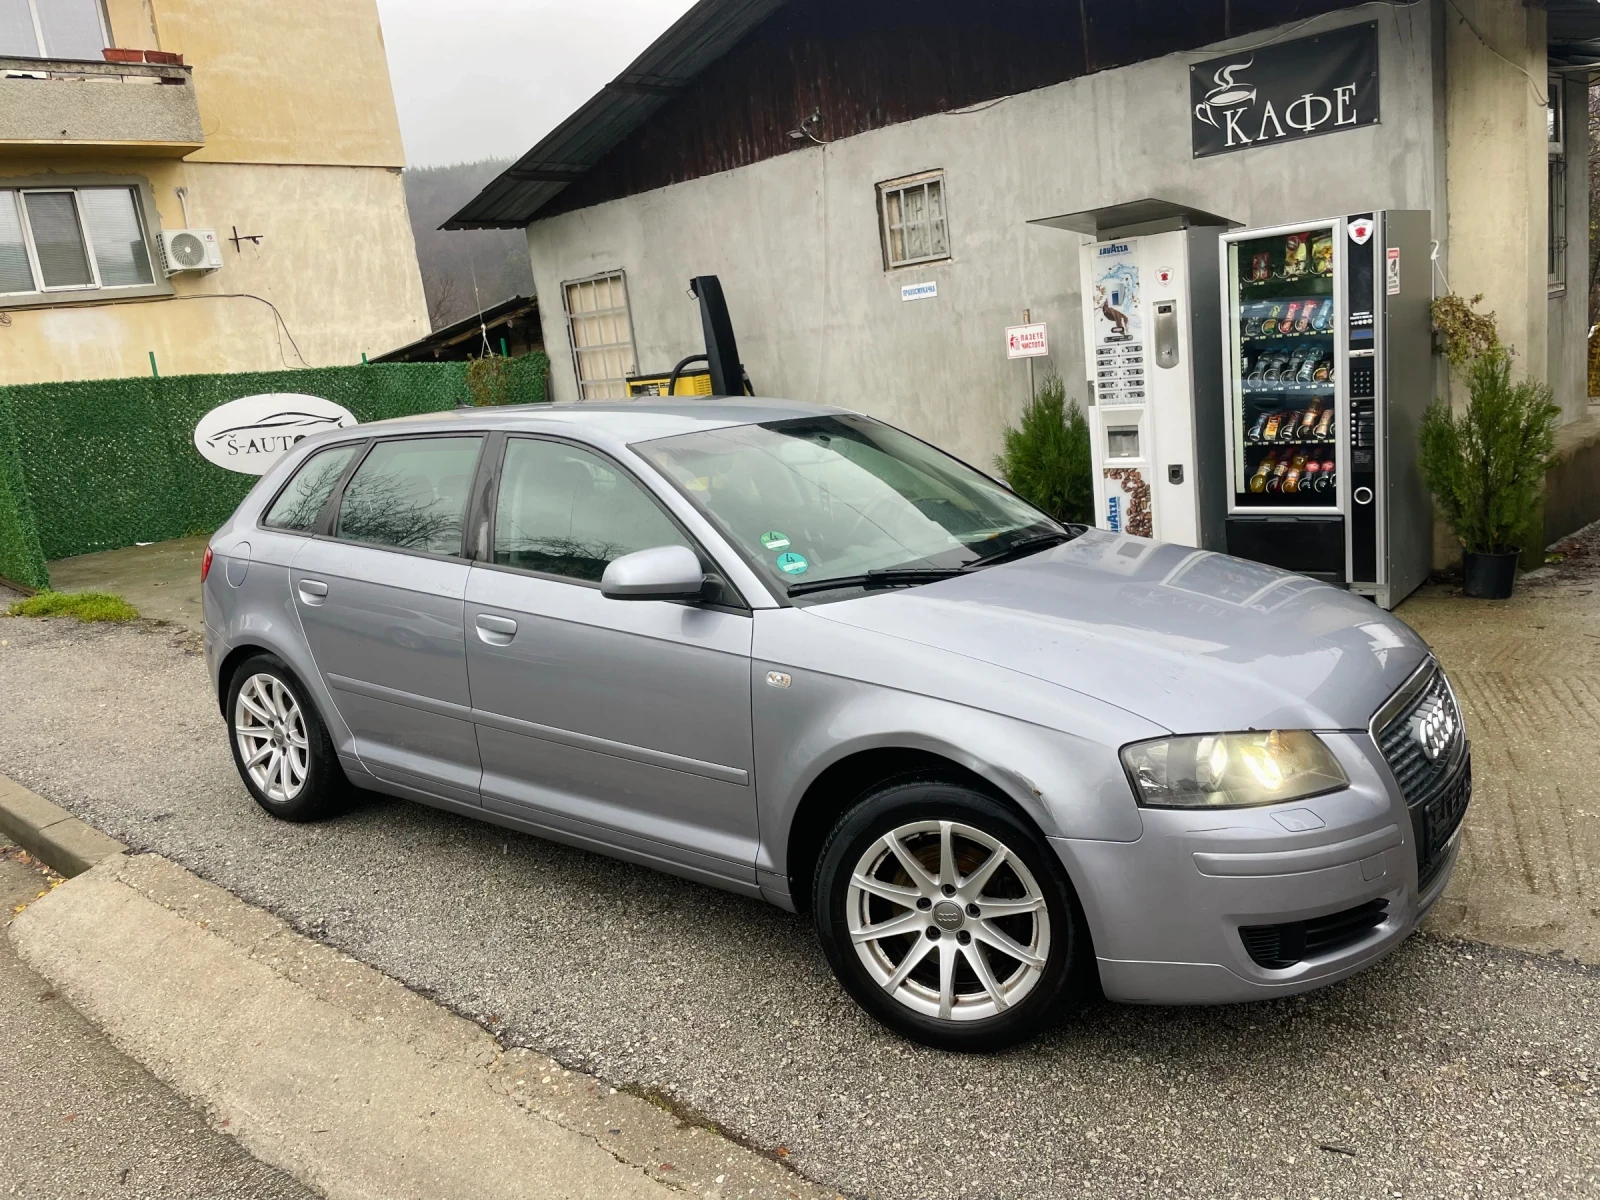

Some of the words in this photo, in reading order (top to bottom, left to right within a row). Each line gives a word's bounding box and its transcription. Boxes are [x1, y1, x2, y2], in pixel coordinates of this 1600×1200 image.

[1223, 82, 1357, 147] КАФЕ
[1099, 244, 1129, 255] LAVAZZA
[1020, 332, 1044, 342] ПАЗЕТЕ
